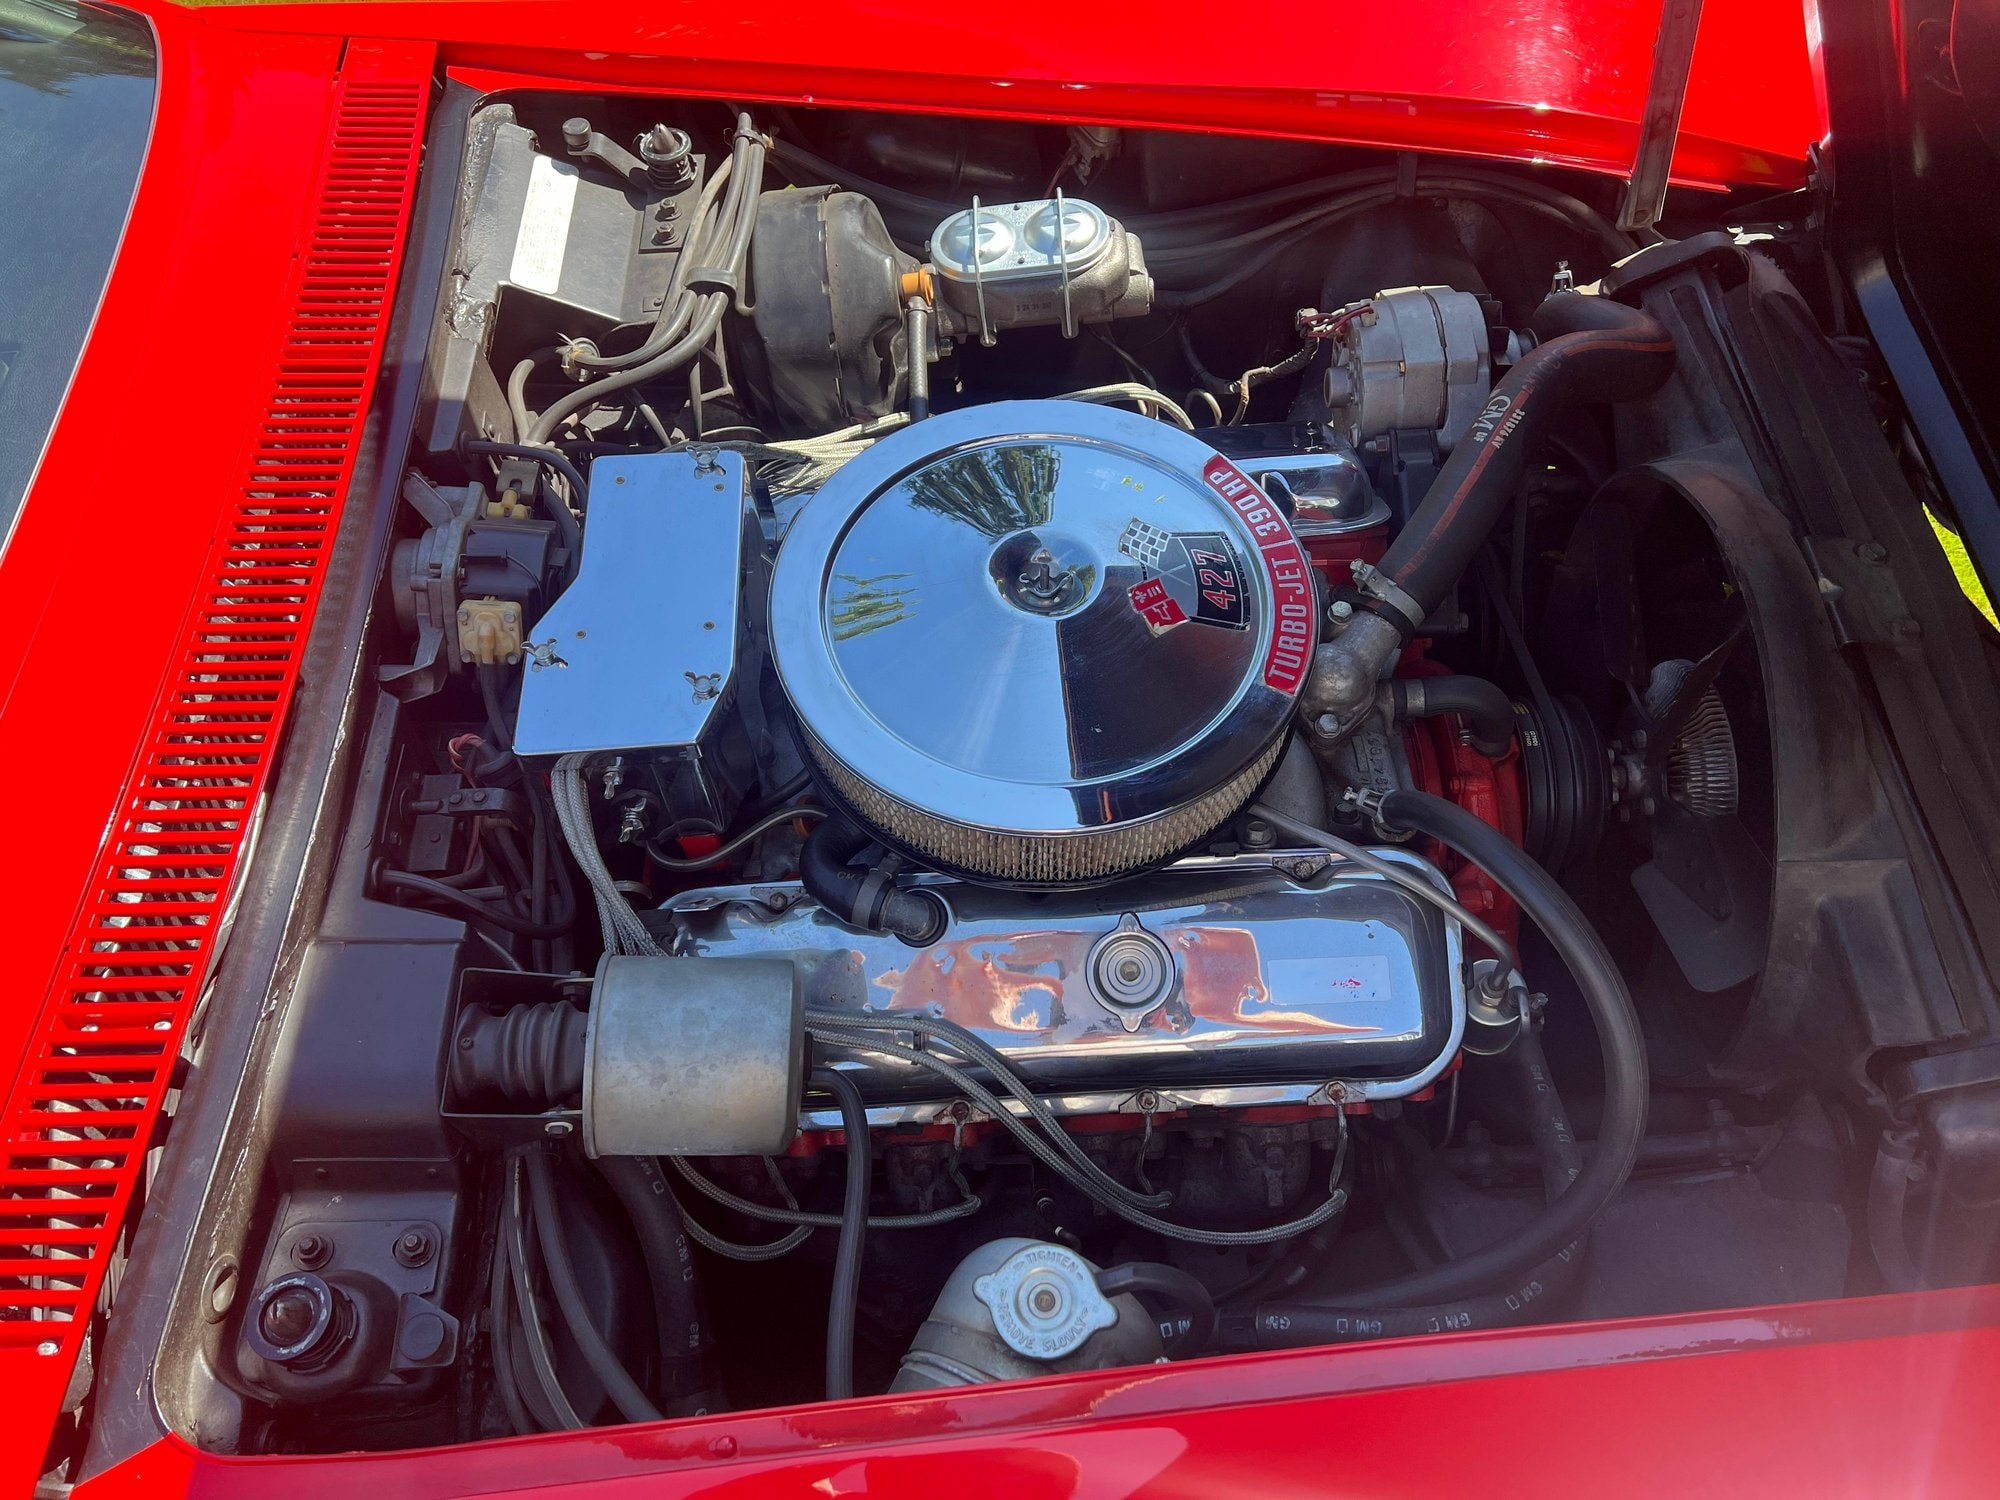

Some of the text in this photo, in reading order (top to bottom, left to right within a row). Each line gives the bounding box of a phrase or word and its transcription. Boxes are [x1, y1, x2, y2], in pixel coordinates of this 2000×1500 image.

[1472, 395, 1511, 431] GM
[1190, 548, 1236, 610] 427
[1268, 557, 1307, 681] TURBO-JET
[1025, 1250, 1079, 1274] TIGHTEN
[1444, 1312, 1472, 1329] GM
